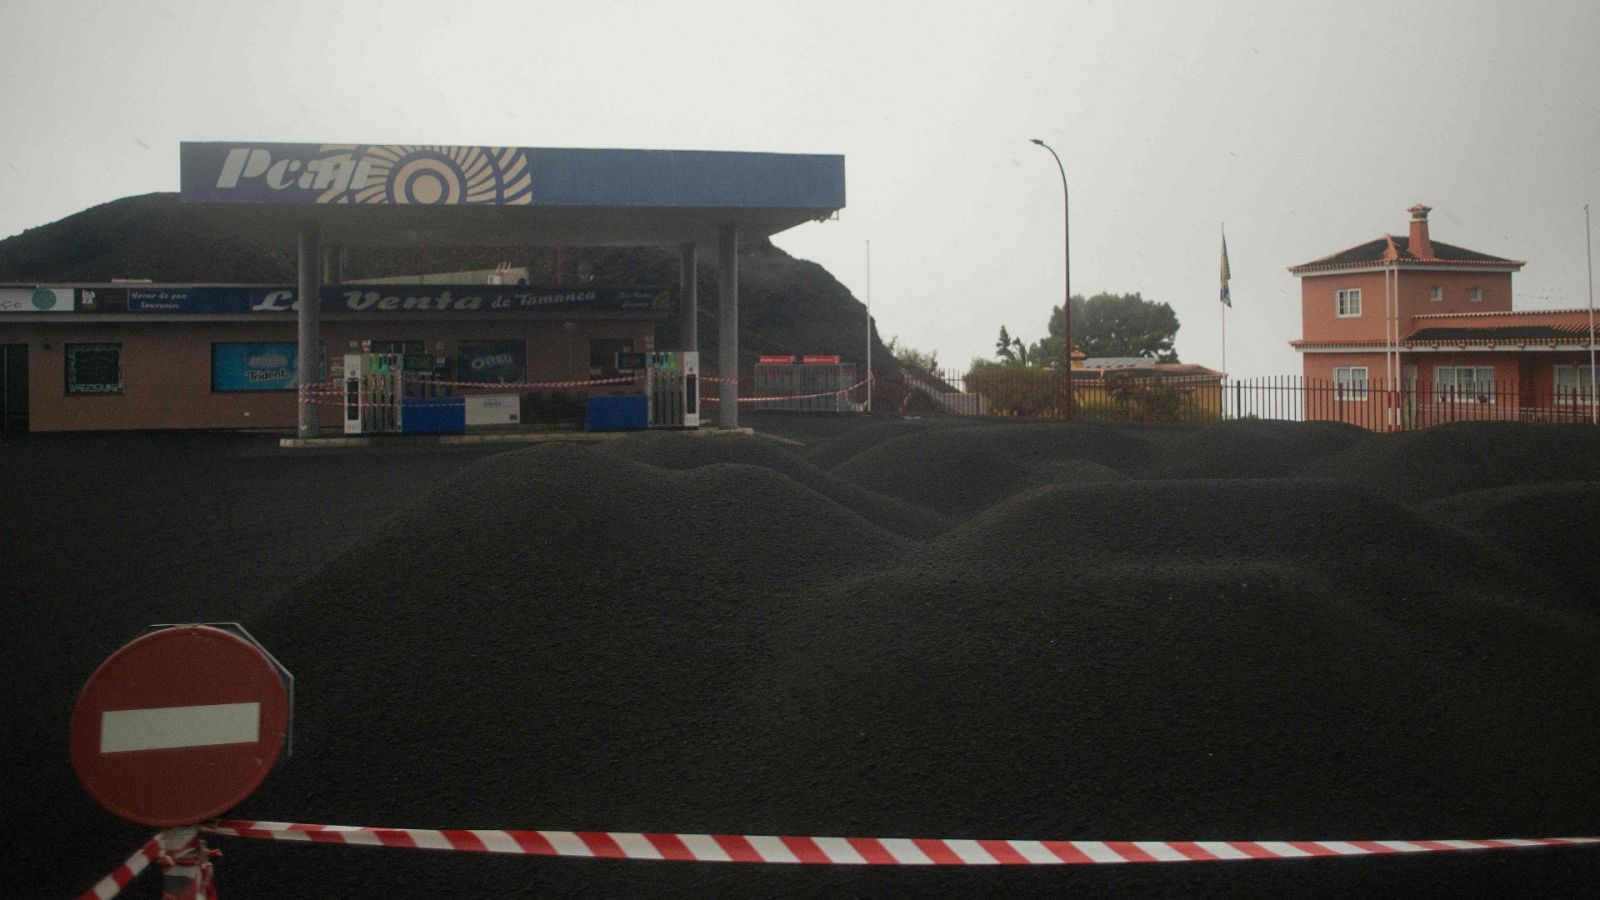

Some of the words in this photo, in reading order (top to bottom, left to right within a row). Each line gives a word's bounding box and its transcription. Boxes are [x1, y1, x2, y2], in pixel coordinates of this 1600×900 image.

[251, 289, 301, 312] L
[342, 288, 482, 311] Venta
[491, 294, 511, 309] de
[513, 290, 597, 306] Tamanca
[247, 369, 288, 383] Trident
